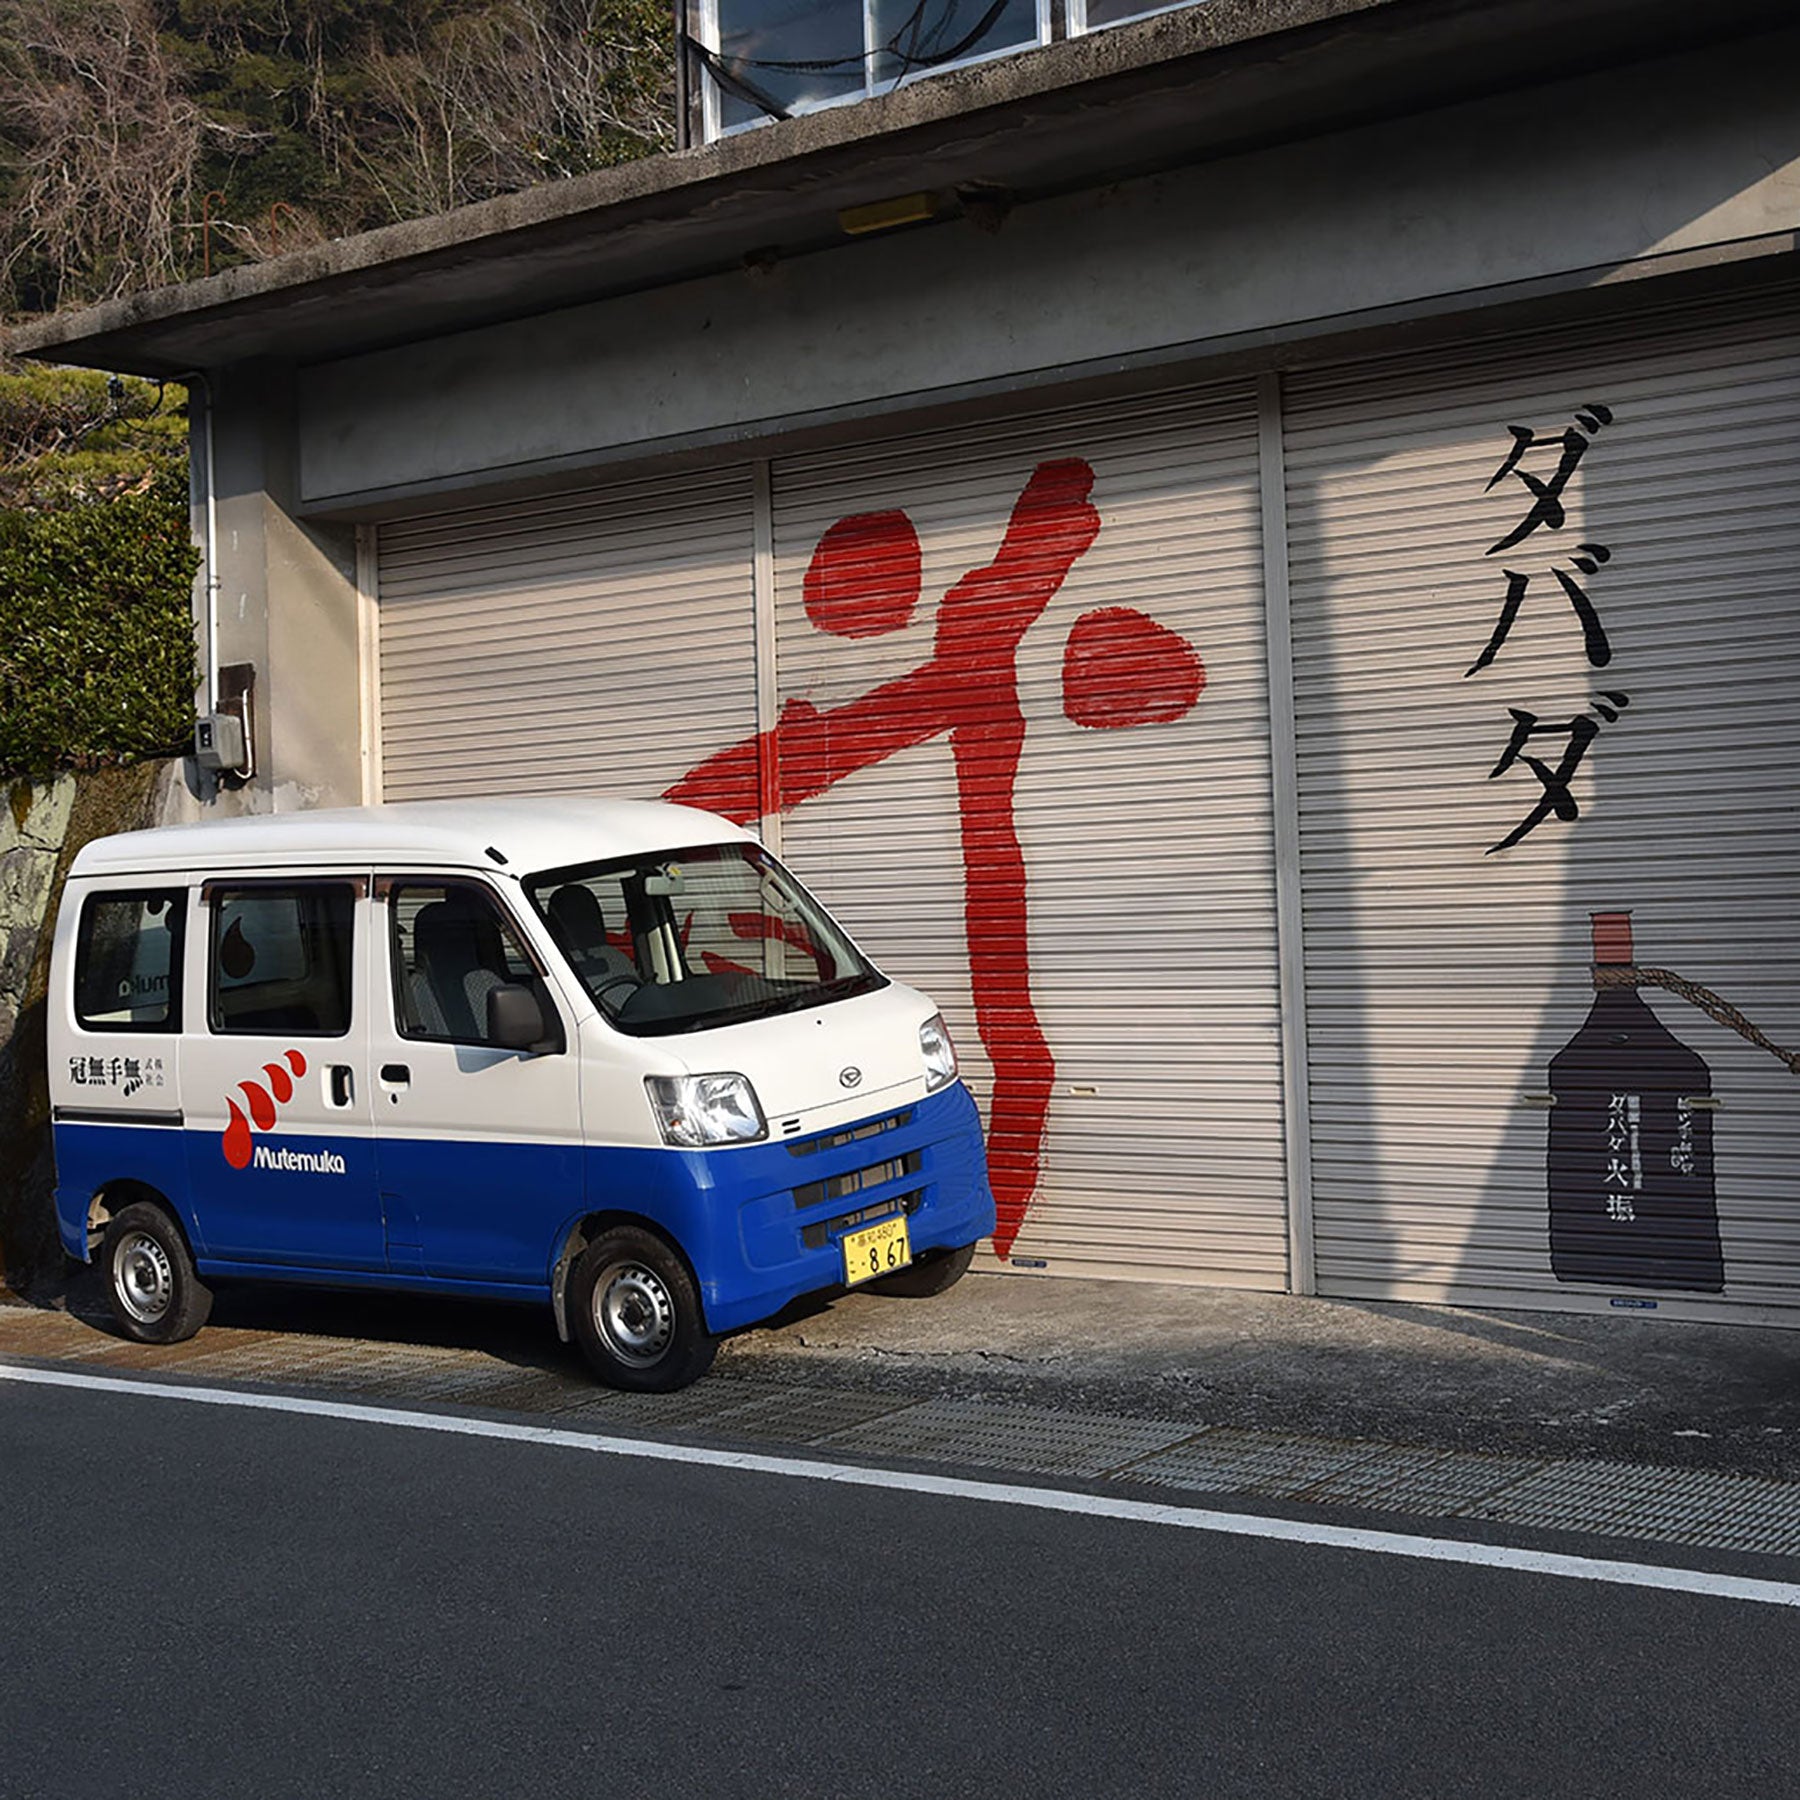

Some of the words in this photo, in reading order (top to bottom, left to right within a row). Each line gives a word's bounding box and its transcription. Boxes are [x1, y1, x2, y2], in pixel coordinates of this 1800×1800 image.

[1464, 403, 1629, 857] ダバダ
[253, 1146, 346, 1174] Mutemuka
